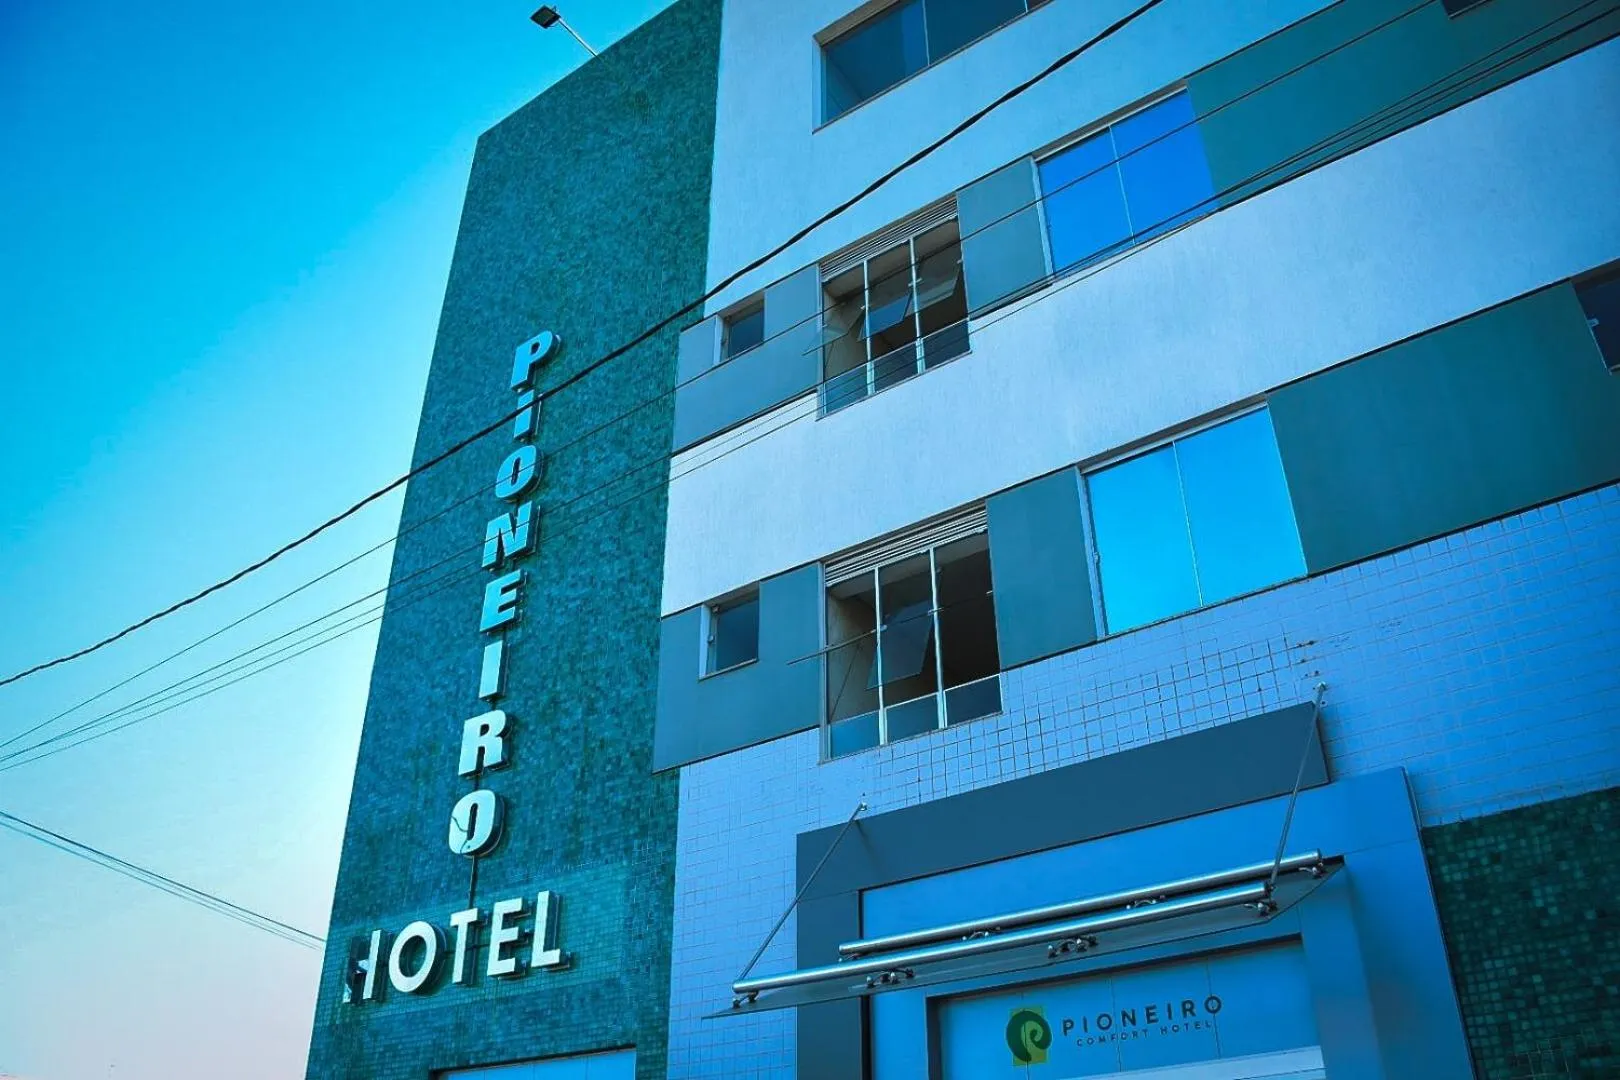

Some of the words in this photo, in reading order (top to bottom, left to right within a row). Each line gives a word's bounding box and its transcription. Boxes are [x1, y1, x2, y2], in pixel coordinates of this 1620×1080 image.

[449, 330, 555, 856] PIONEIRO
[342, 890, 562, 1003] HOTEL
[1062, 995, 1222, 1036] PIONEIRO
[1076, 1029, 1149, 1047] COMFORT
[1160, 1019, 1212, 1036] HOTEL
